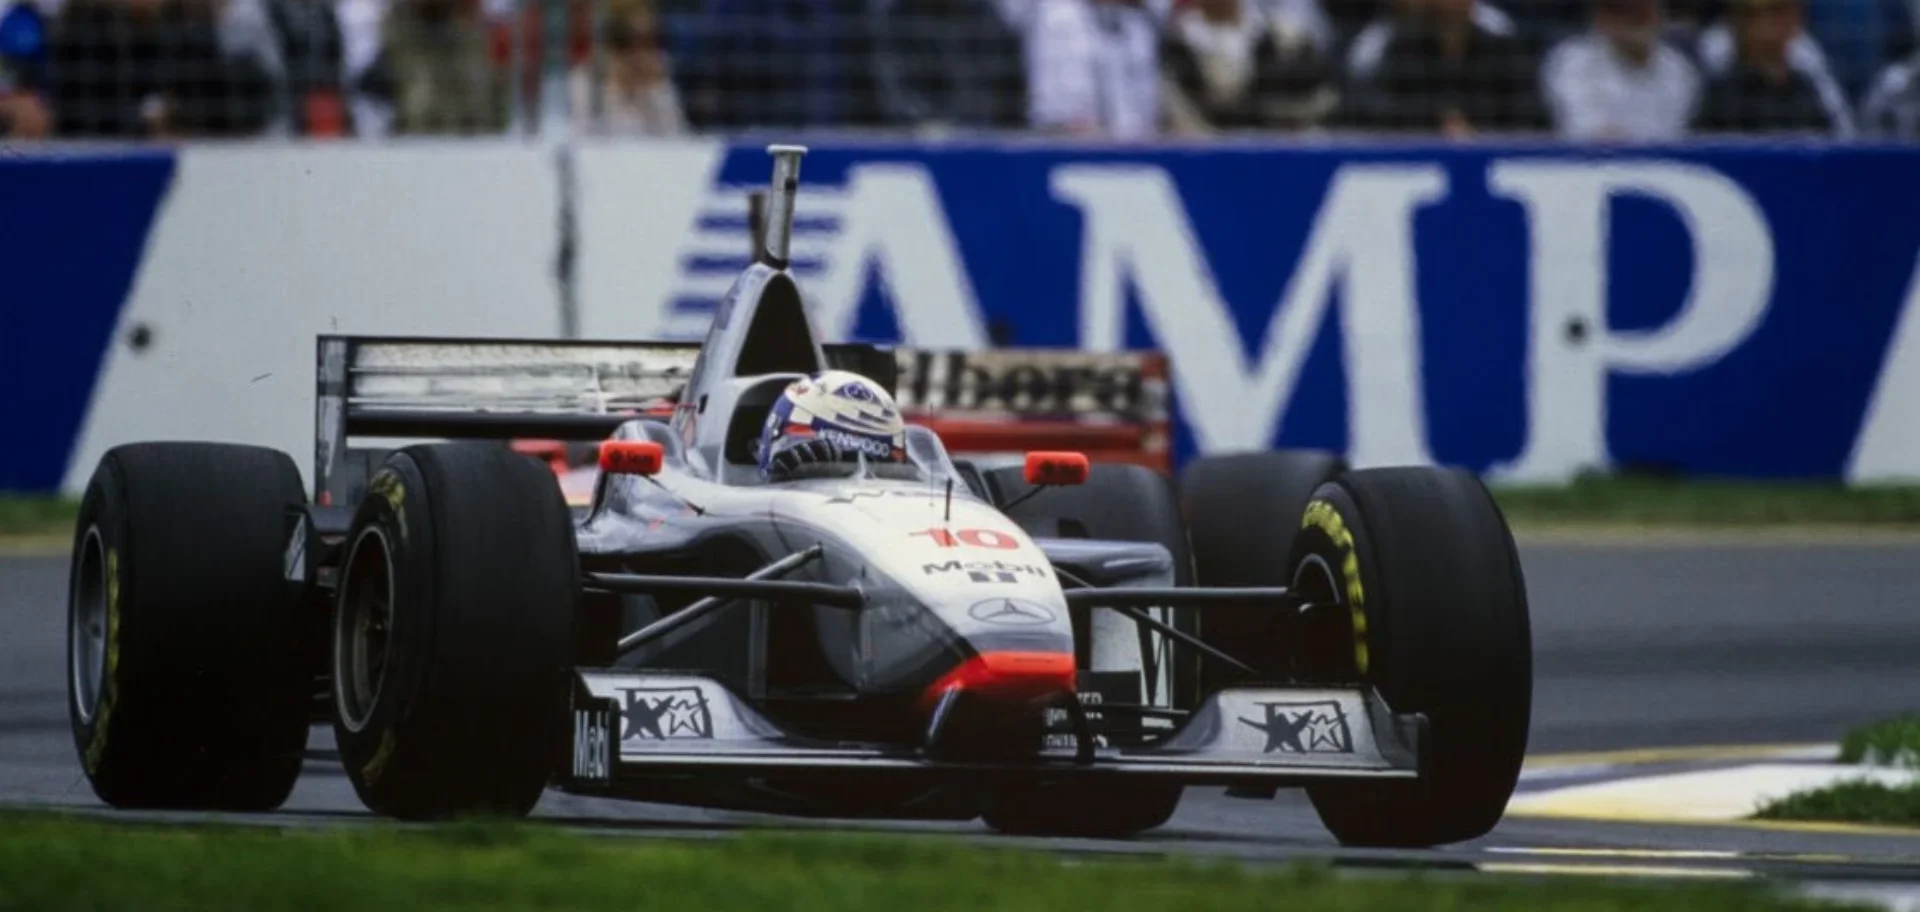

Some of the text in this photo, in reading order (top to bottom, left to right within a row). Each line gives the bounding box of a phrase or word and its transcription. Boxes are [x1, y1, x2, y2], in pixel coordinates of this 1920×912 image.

[808, 161, 1775, 485] AMP
[909, 528, 1020, 550] 10
[923, 560, 1045, 575] Mobil
